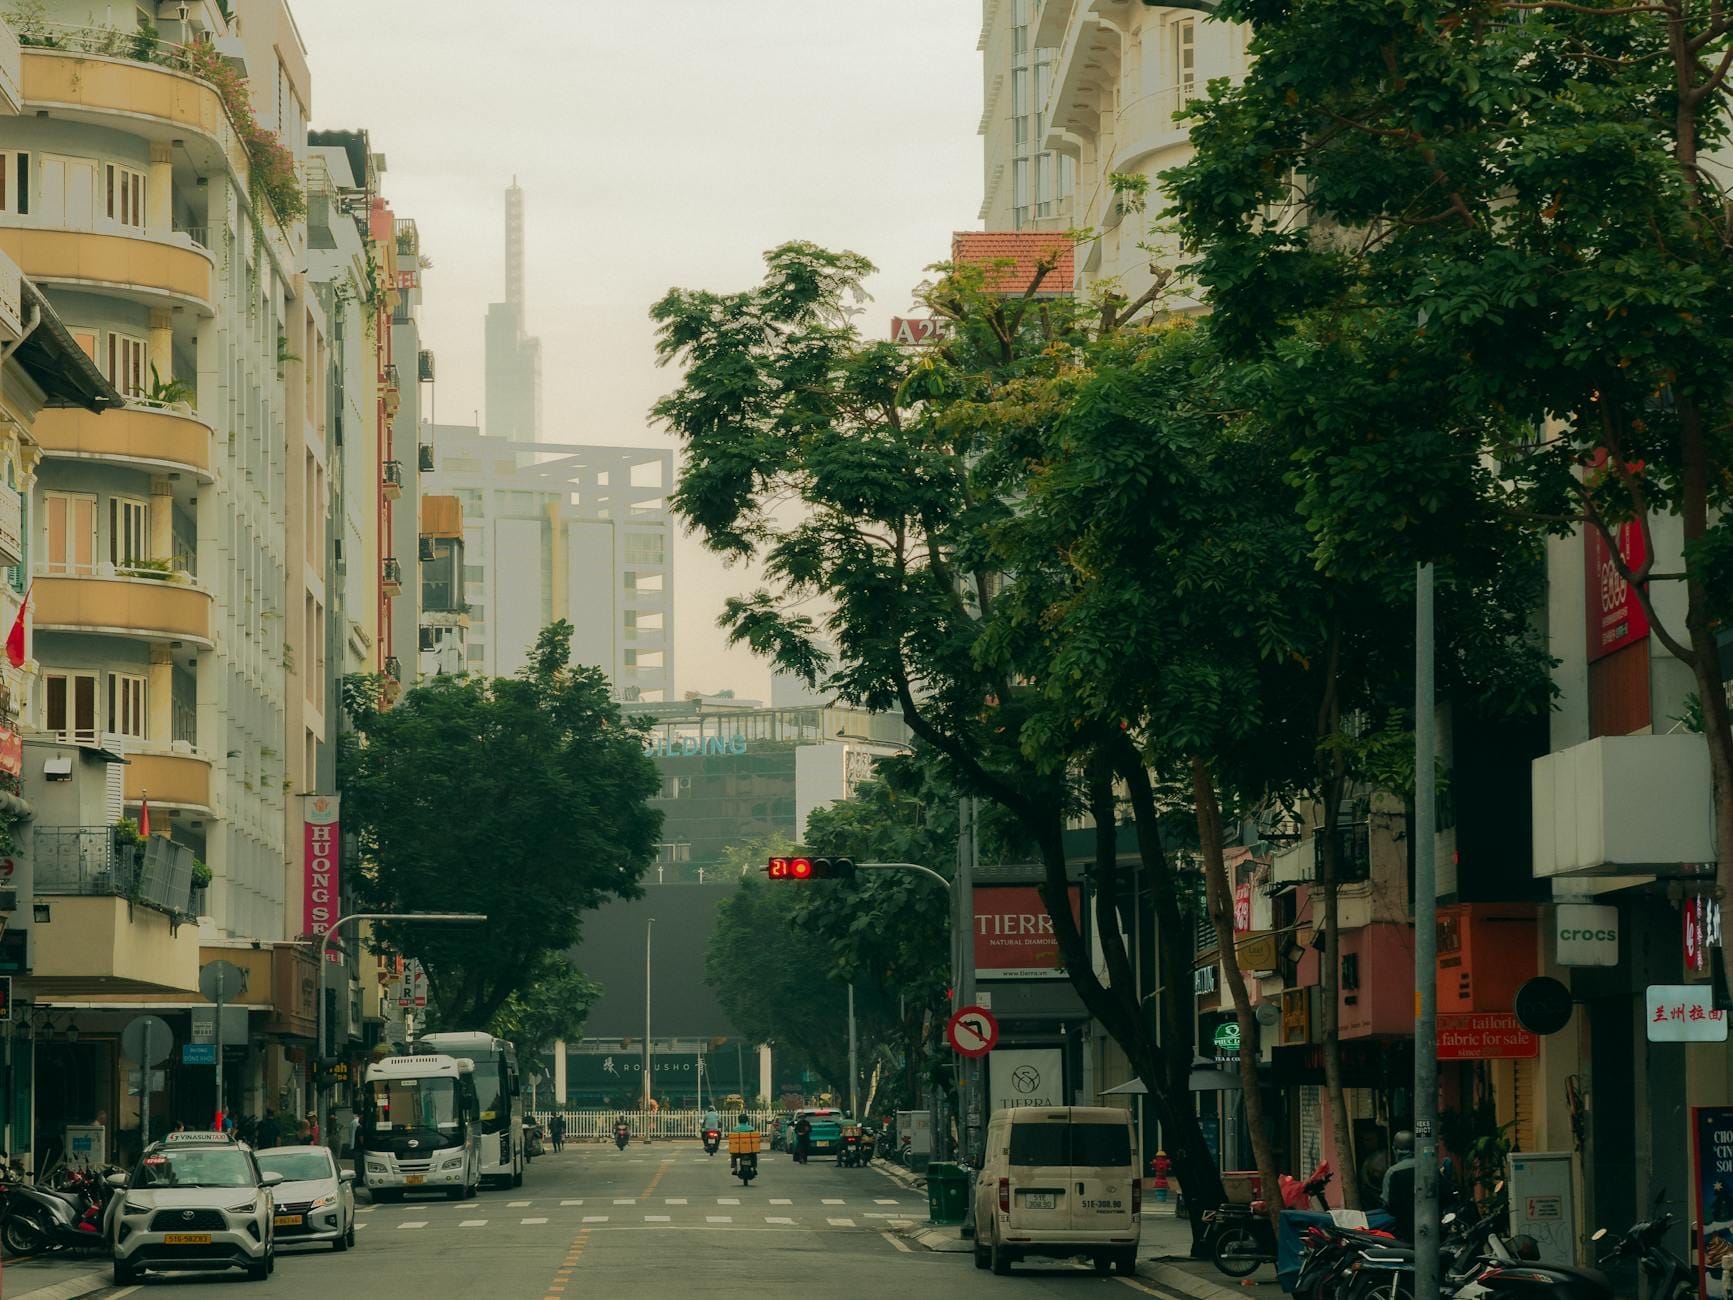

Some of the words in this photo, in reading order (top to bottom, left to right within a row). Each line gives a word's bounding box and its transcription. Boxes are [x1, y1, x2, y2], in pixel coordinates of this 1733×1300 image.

[772, 860, 787, 876] 21
[974, 914, 1055, 935] TIERR
[990, 938, 1022, 946] NATURAL
[1560, 929, 1616, 941] crocs
[1653, 1003, 1723, 1023] 兰州拉面
[1472, 1015, 1522, 1030] tailorin
[1442, 1033, 1480, 1046] fabric
[1482, 1033, 1502, 1046] for
[1503, 1032, 1529, 1046] sale
[1457, 1048, 1480, 1057] since
[624, 1063, 690, 1072] ROUSHO
